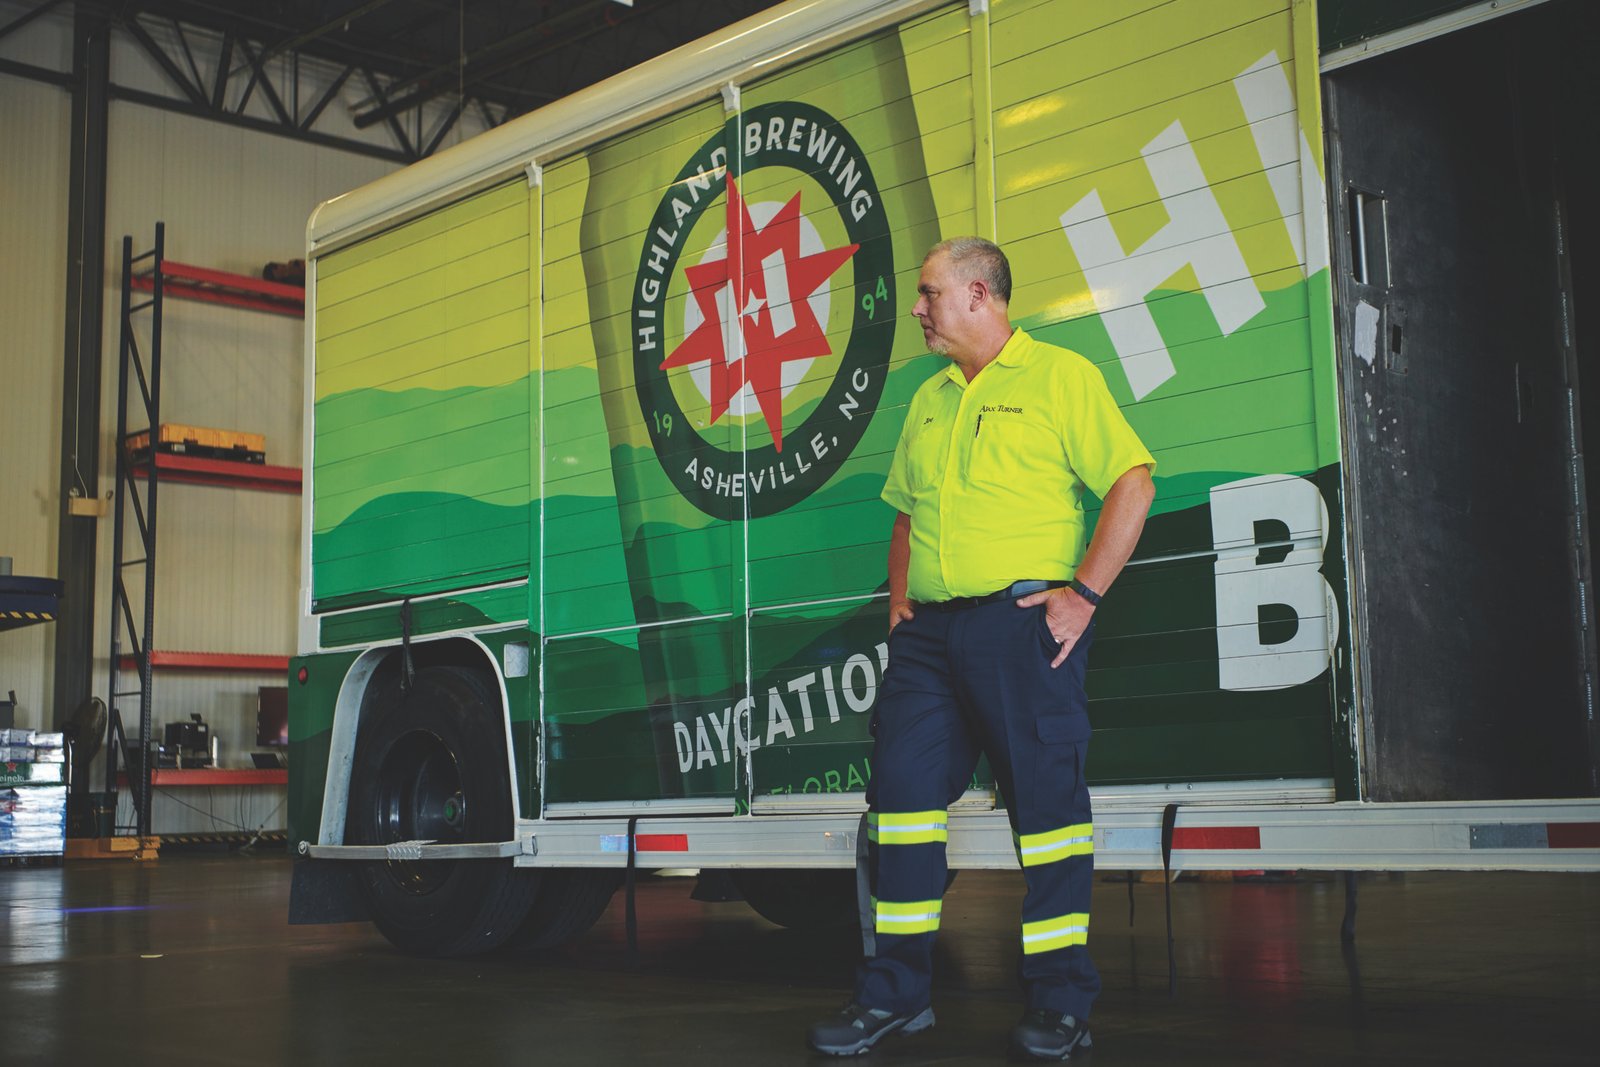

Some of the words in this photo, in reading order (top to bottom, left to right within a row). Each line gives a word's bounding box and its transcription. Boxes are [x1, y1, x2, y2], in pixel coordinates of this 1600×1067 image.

[638, 146, 727, 351] HIGHLAND
[745, 116, 873, 223] BREWING
[862, 275, 888, 320] 94
[653, 410, 673, 437] 19
[685, 432, 838, 497] ASHEVILLE,
[838, 367, 869, 420] NC
[1209, 473, 1340, 692] B
